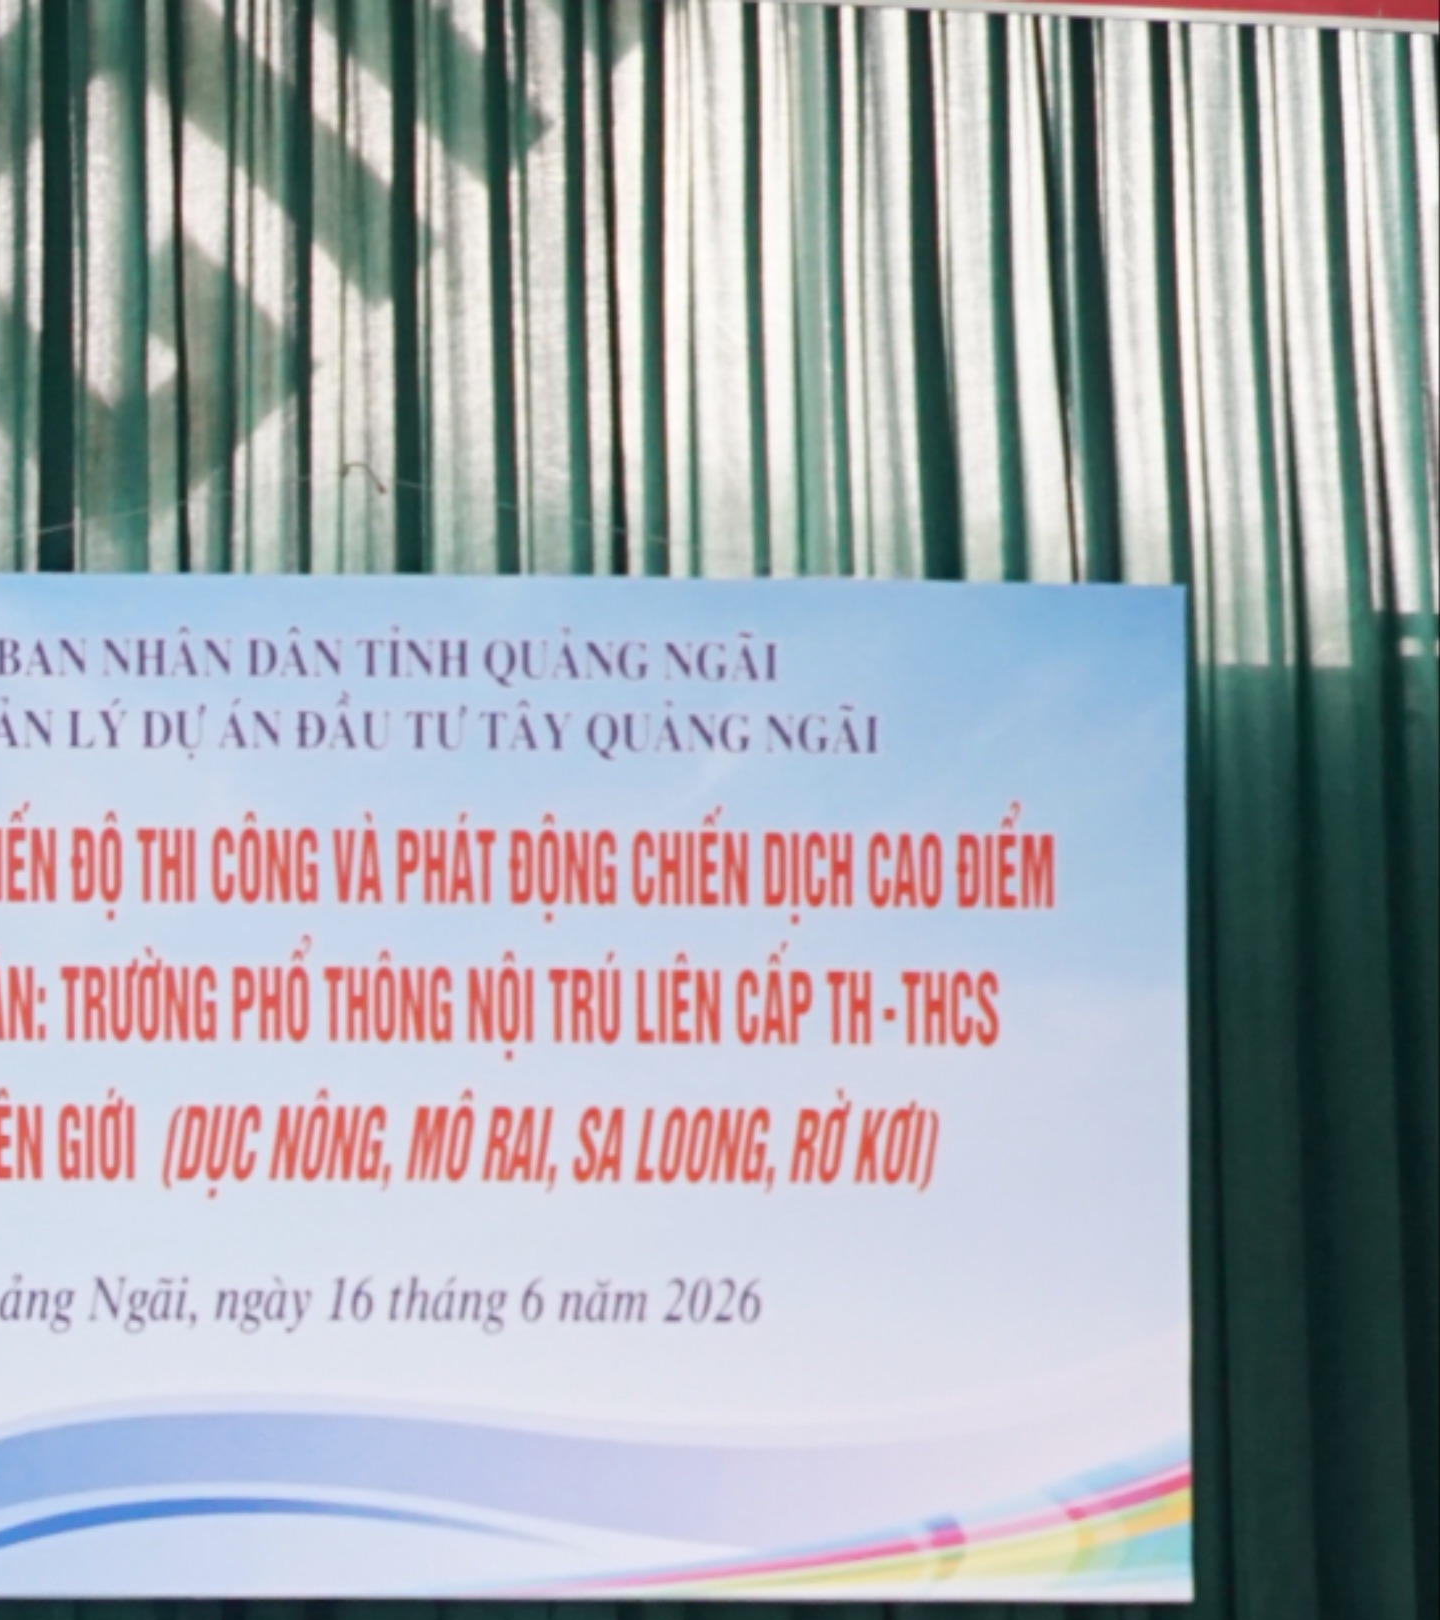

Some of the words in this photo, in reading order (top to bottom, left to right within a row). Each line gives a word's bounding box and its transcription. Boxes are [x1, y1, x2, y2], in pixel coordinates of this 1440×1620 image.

[103, 626, 231, 677] NHÂN
[248, 626, 341, 677] DÂN
[357, 626, 468, 678] TỈNH
[483, 627, 648, 688] QUẢNG
[665, 631, 777, 681] NGÃI
[69, 698, 129, 749] LÝ
[143, 703, 207, 759] DỰ
[220, 698, 280, 749] ÁN
[296, 692, 388, 750] ĐẦU
[406, 705, 468, 750] TƯ
[480, 699, 570, 751] TÂY
[585, 700, 750, 761] QUẢNG
[767, 704, 877, 754] NGÃI
[70, 810, 123, 921] ĐỘ
[136, 827, 197, 903] THI
[211, 811, 319, 905] CÔNG
[332, 812, 383, 904] VÀ
[396, 813, 497, 904] PHÁT
[508, 813, 618, 923] ĐỘNG
[631, 806, 750, 907] CHIẾN
[763, 831, 854, 925] DỊCH
[867, 831, 943, 909] CAO
[956, 802, 1055, 909] ĐIỂM
[60, 947, 218, 1043] TRƯỜNG
[231, 934, 311, 1043] PHỔ
[323, 949, 453, 1043] THÔNG
[467, 950, 535, 1061] NỘI
[547, 951, 622, 1045] TRÚ
[636, 952, 722, 1045] LIÊN
[735, 942, 814, 1045] CẤP
[57, 1088, 136, 1182] GIỚI
[162, 1103, 263, 1199] (DỤC
[268, 1088, 392, 1190] NÔNG,
[406, 1088, 476, 1183] MÔ
[482, 1105, 558, 1192] RAI,
[572, 1105, 625, 1183] SA
[634, 1106, 776, 1193] LOONG,
[789, 1089, 849, 1185] RỜ
[89, 1275, 198, 1332] Ngãi,
[214, 1276, 313, 1334] ngày
[329, 1276, 375, 1322] 16
[388, 1275, 508, 1334] tháng
[520, 1278, 545, 1322] 6
[558, 1281, 648, 1323] năm
[663, 1277, 762, 1324] 2026
